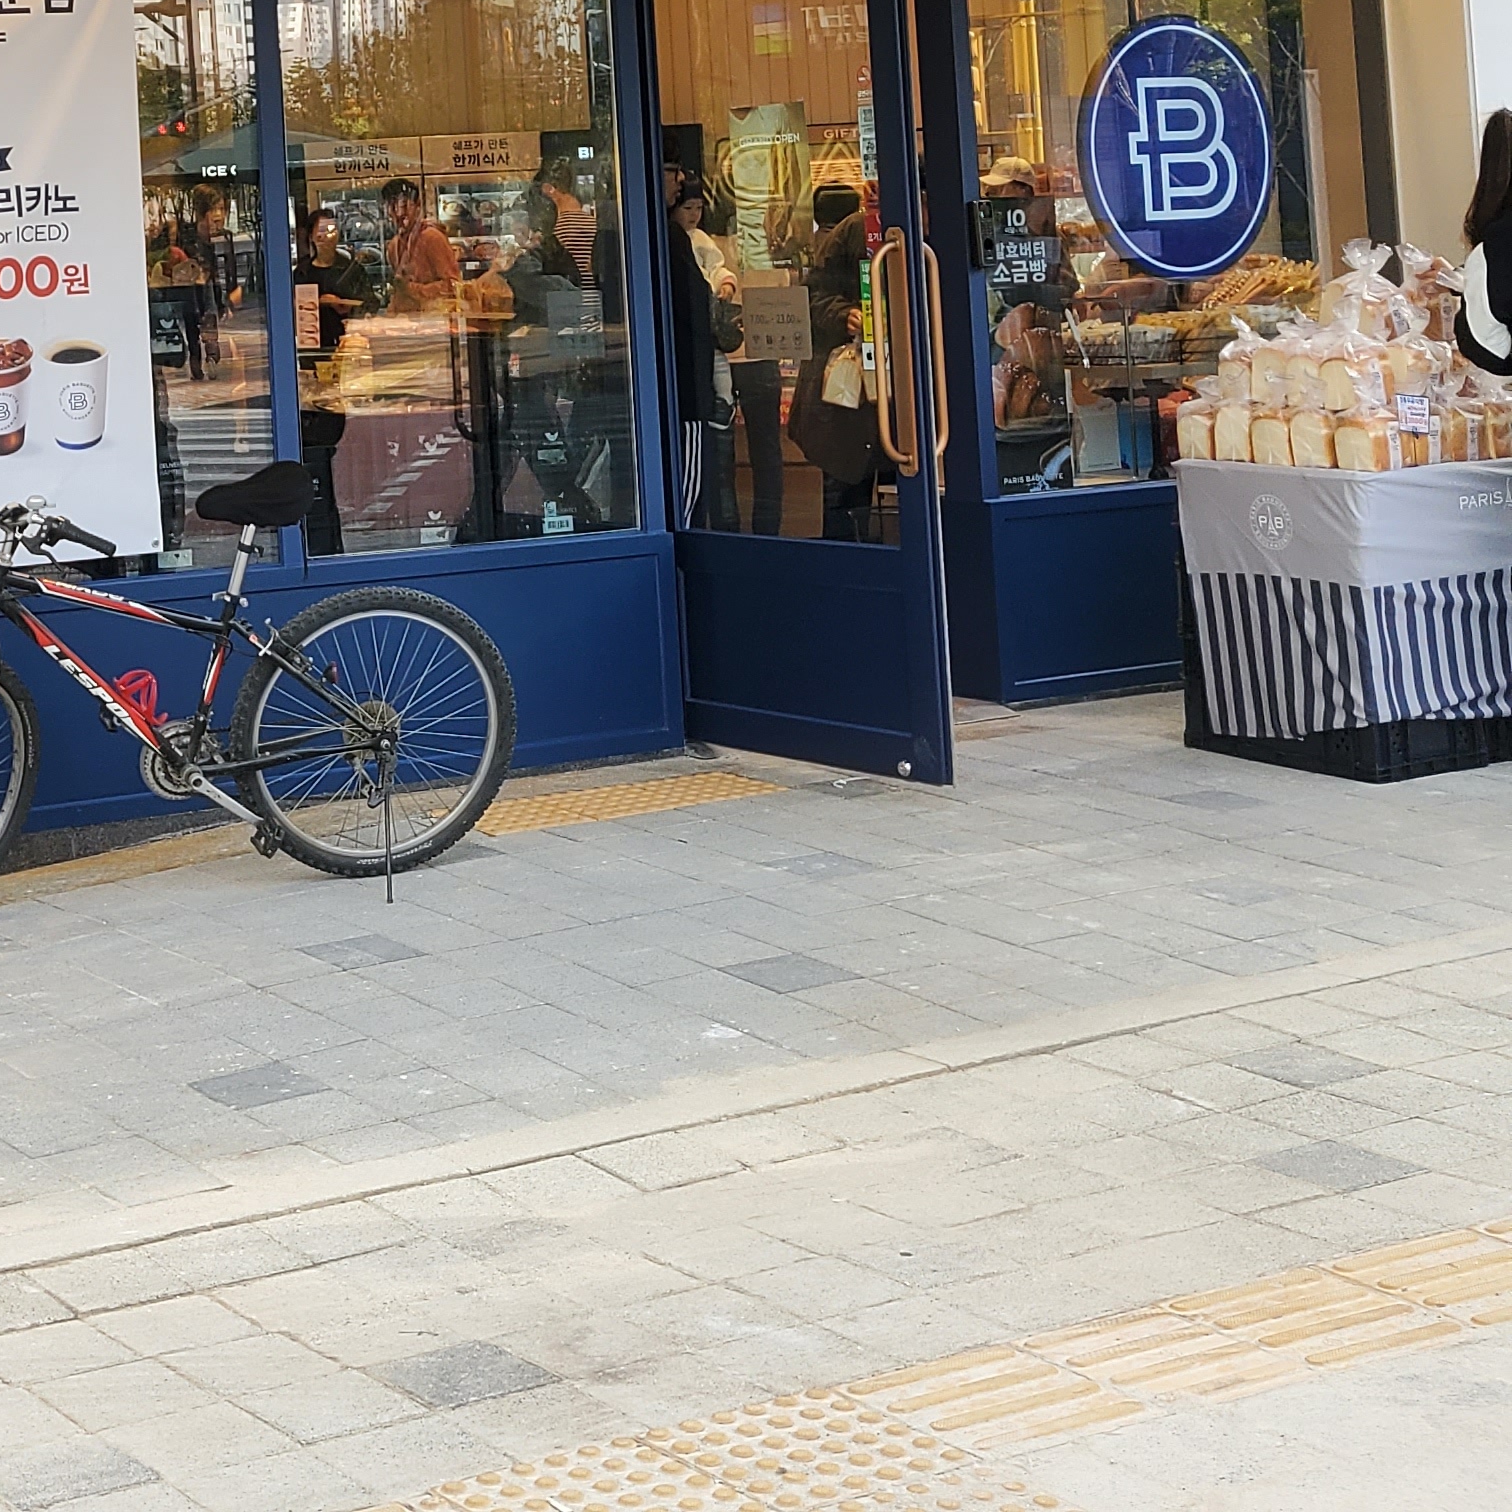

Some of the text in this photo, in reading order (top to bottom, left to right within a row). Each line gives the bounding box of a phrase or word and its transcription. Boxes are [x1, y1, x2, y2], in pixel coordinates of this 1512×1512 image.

[367, 143, 389, 156] 만든
[488, 137, 509, 150] 만든
[334, 157, 390, 174] 한끼식사
[452, 152, 511, 168] 한끼식사
[201, 165, 228, 178] ICE
[15, 223, 71, 245] ICED)
[992, 259, 1048, 284] 소금빵
[1003, 476, 1025, 485] PARIS
[1458, 490, 1504, 510] PARIS
[42, 644, 130, 720] LESPO
